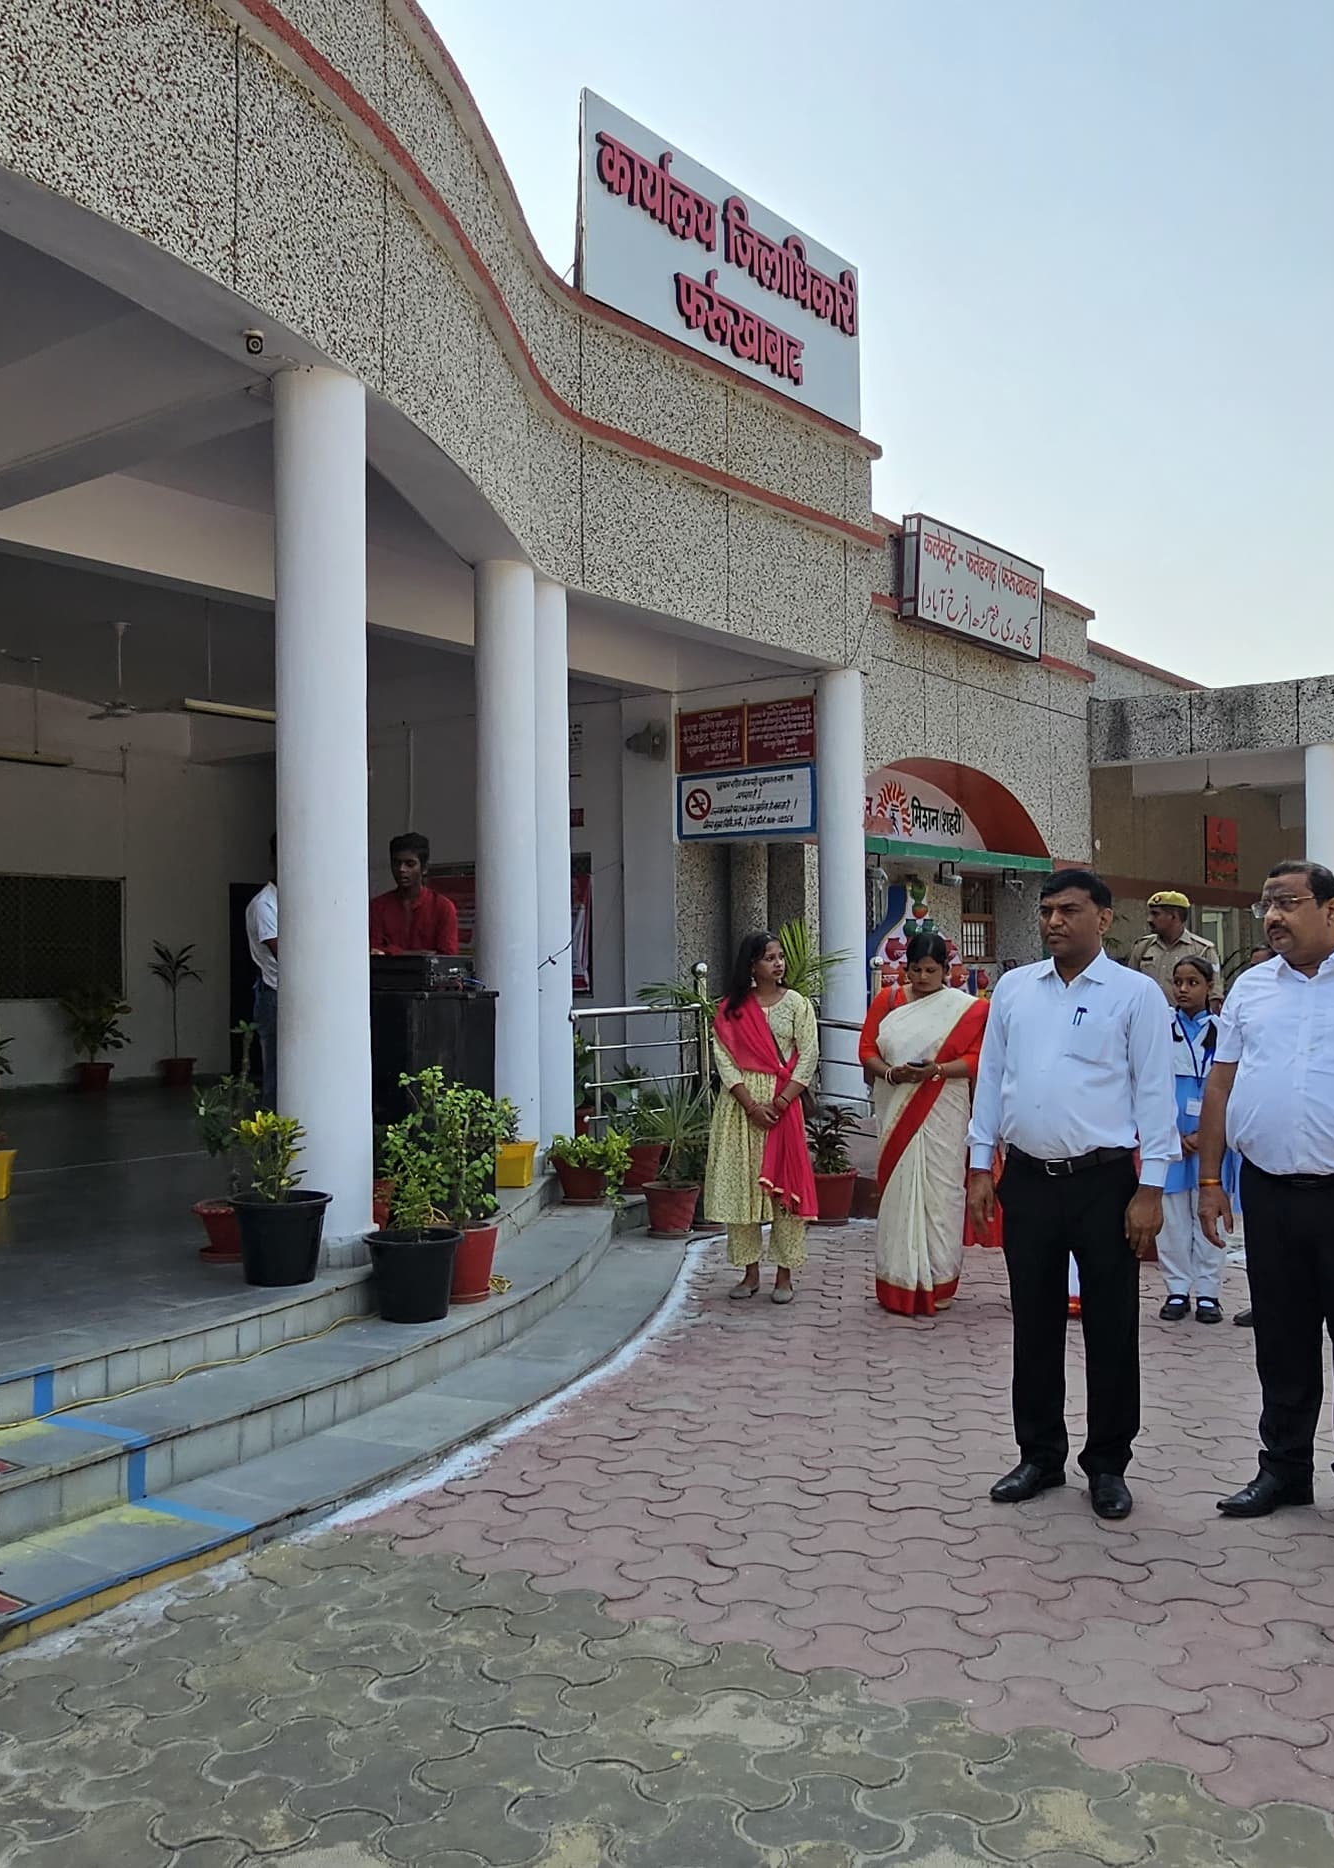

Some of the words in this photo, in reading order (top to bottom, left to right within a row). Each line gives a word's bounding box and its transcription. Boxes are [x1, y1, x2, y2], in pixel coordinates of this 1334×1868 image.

[596, 131, 717, 252] कार्यालय
[722, 196, 858, 337] जिलाधिकारी
[911, 796, 940, 833] मिशन
[940, 806, 964, 836] (शहरी)
